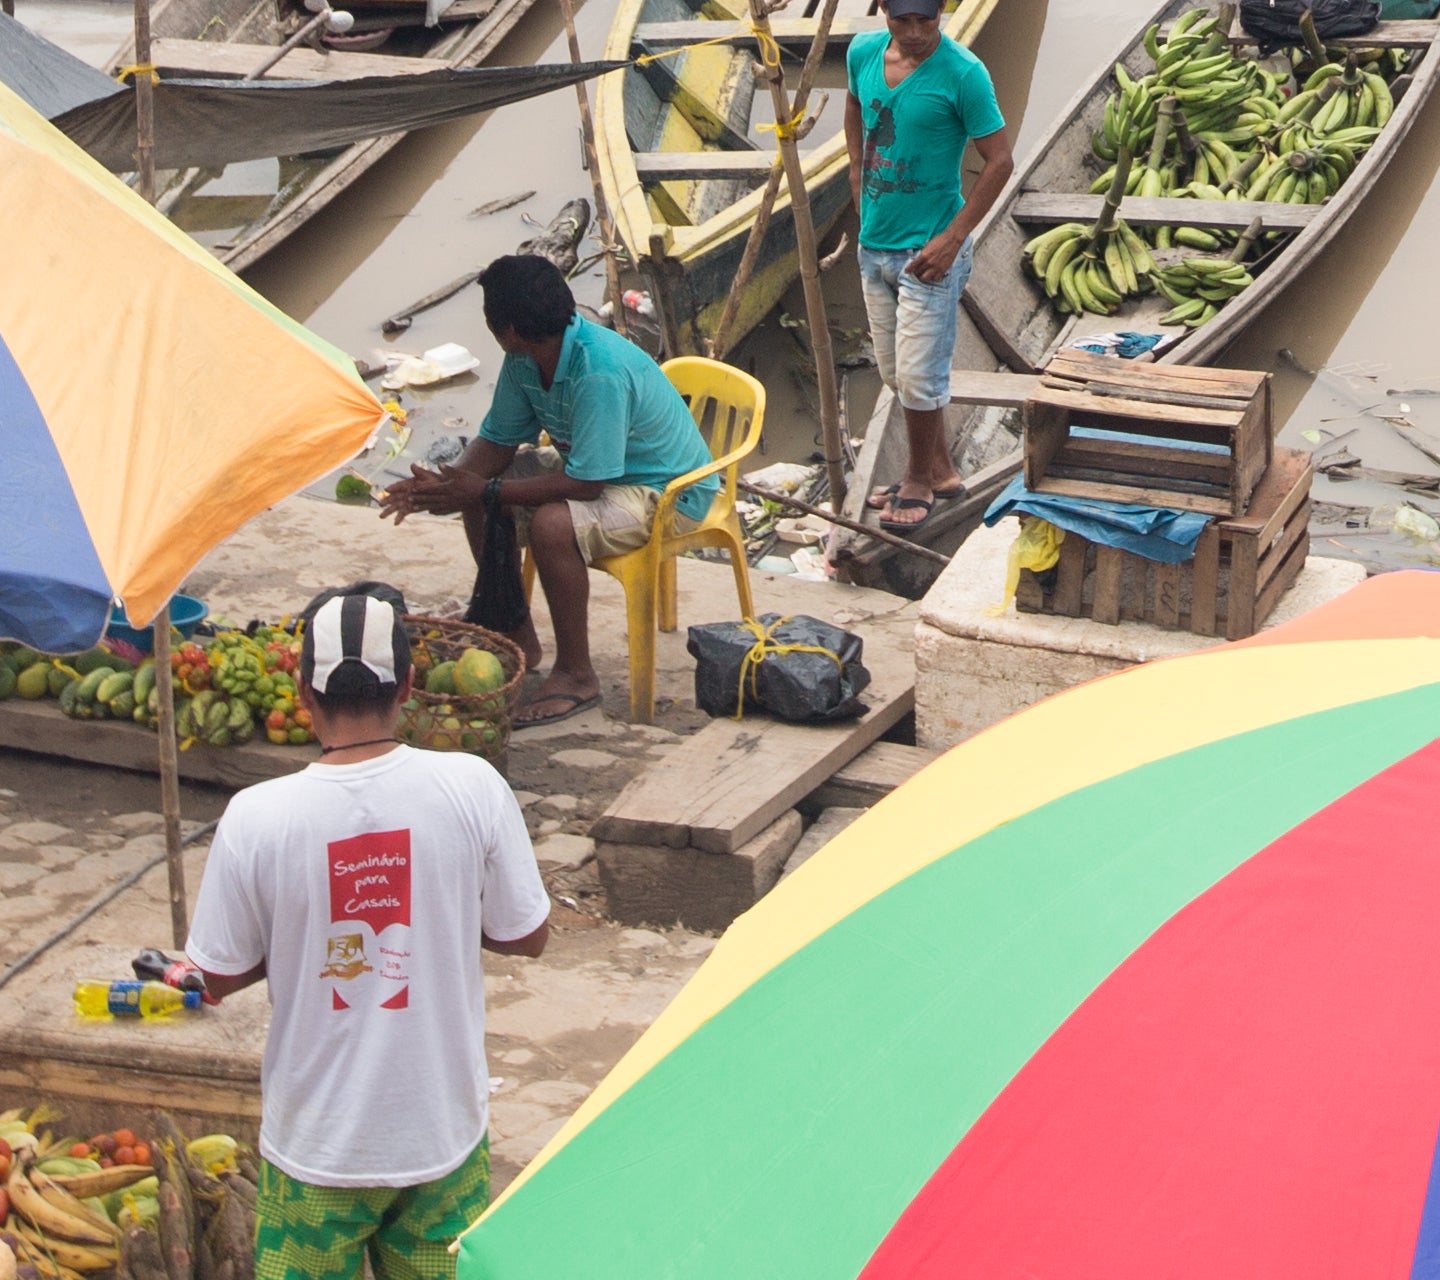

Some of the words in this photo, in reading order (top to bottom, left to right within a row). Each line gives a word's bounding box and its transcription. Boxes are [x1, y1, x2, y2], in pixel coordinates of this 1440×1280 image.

[334, 853, 407, 877] Seminário
[355, 875, 389, 894] para
[344, 895, 401, 914] Casais
